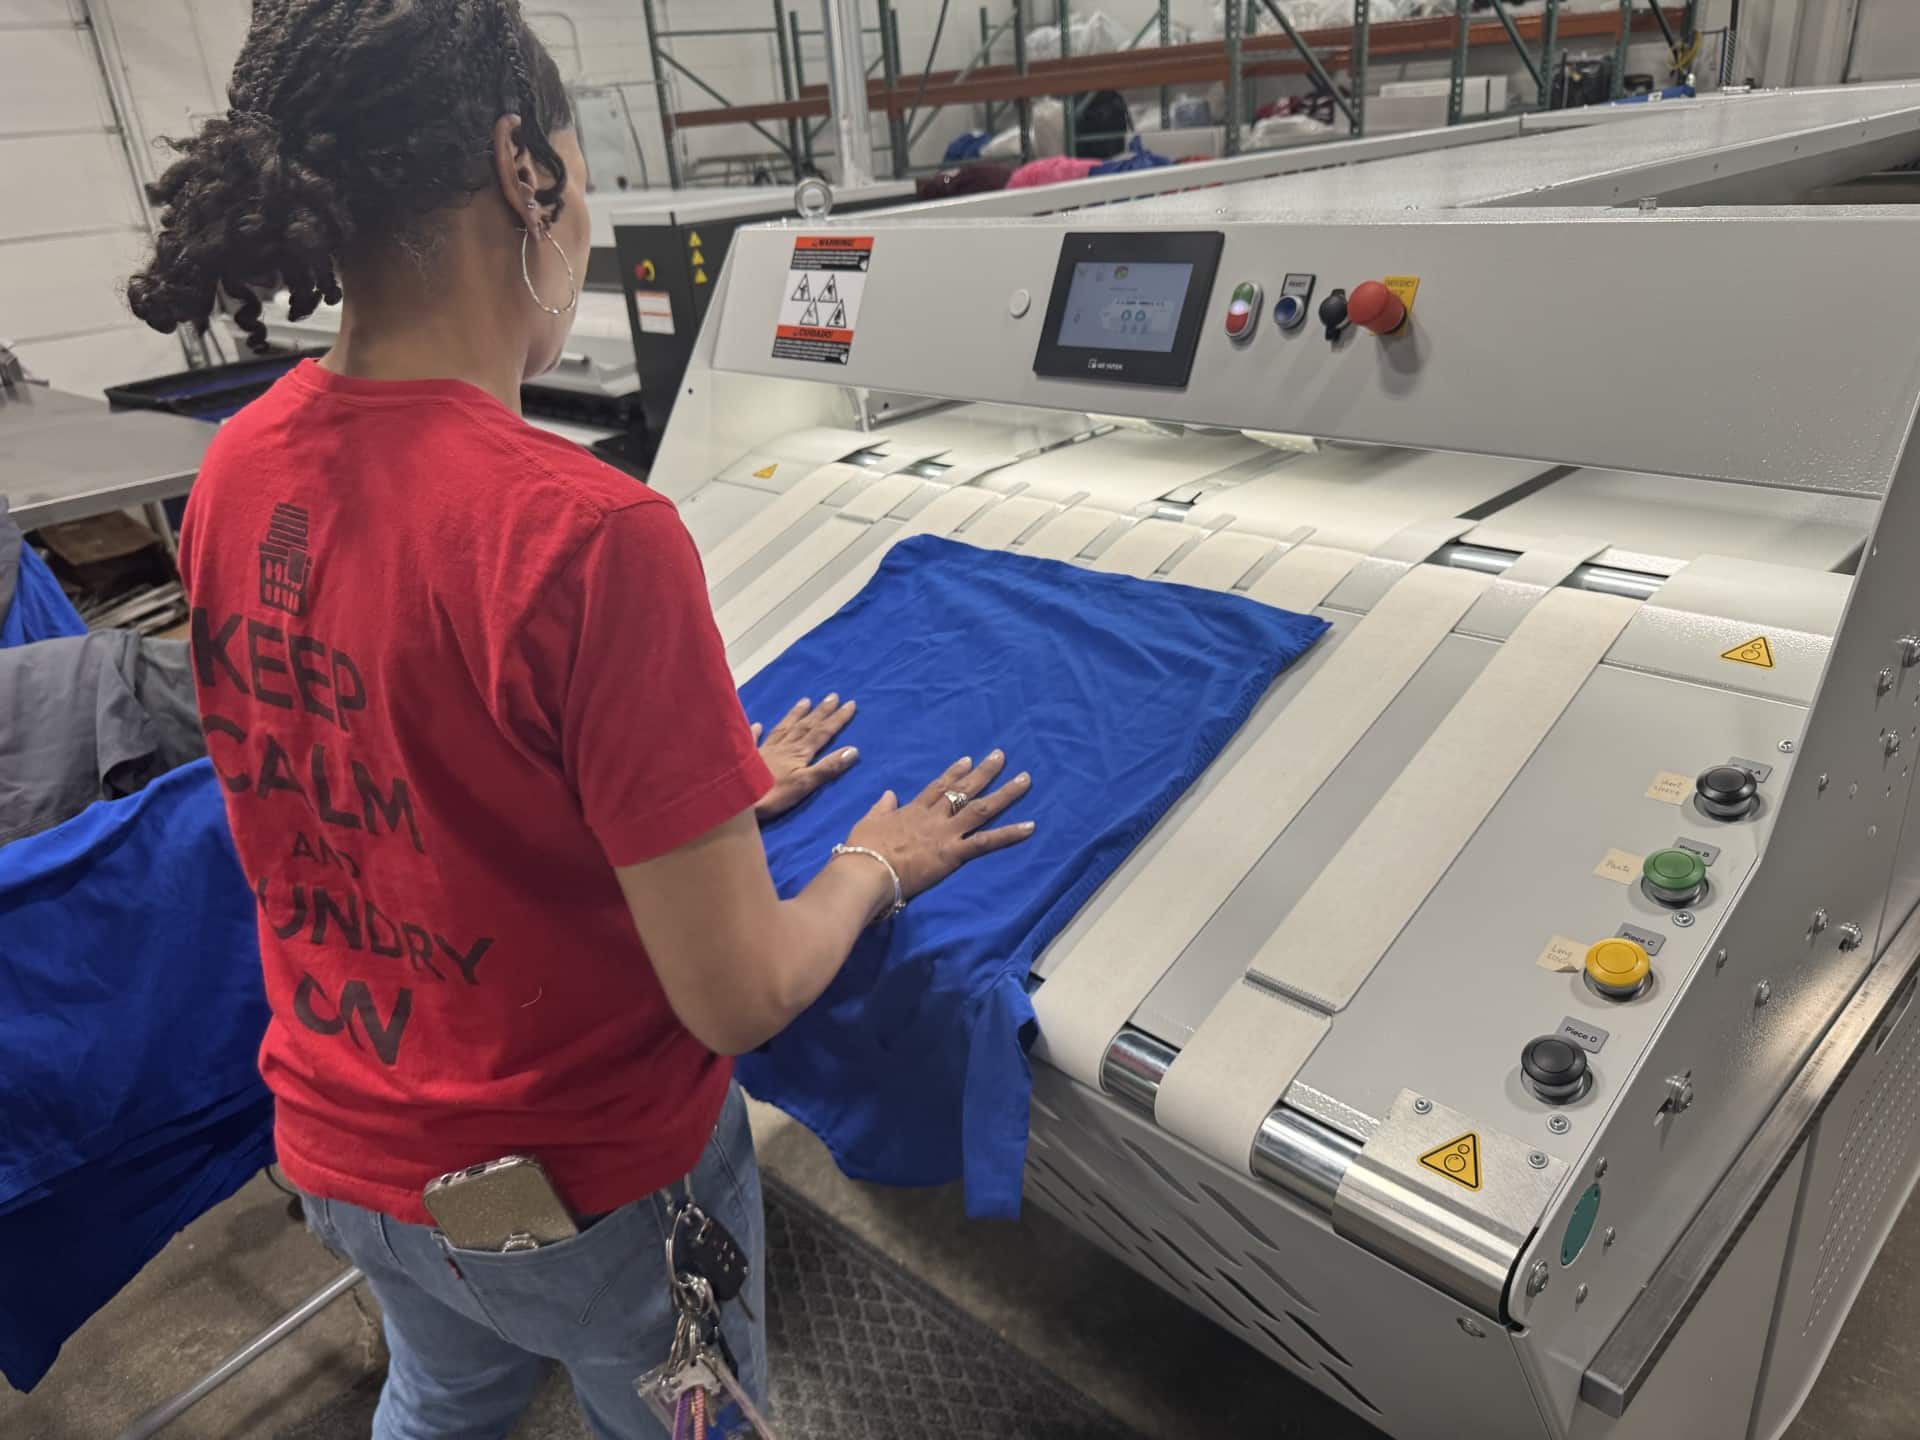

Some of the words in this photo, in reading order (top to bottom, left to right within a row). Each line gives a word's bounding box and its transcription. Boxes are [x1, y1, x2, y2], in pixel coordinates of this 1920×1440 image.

[192, 607, 367, 732] KEEP
[202, 714, 425, 854] CALM
[257, 877, 495, 986] UNDRY
[1565, 1026, 1588, 1040] Piece
[1590, 1035, 1598, 1043] D
